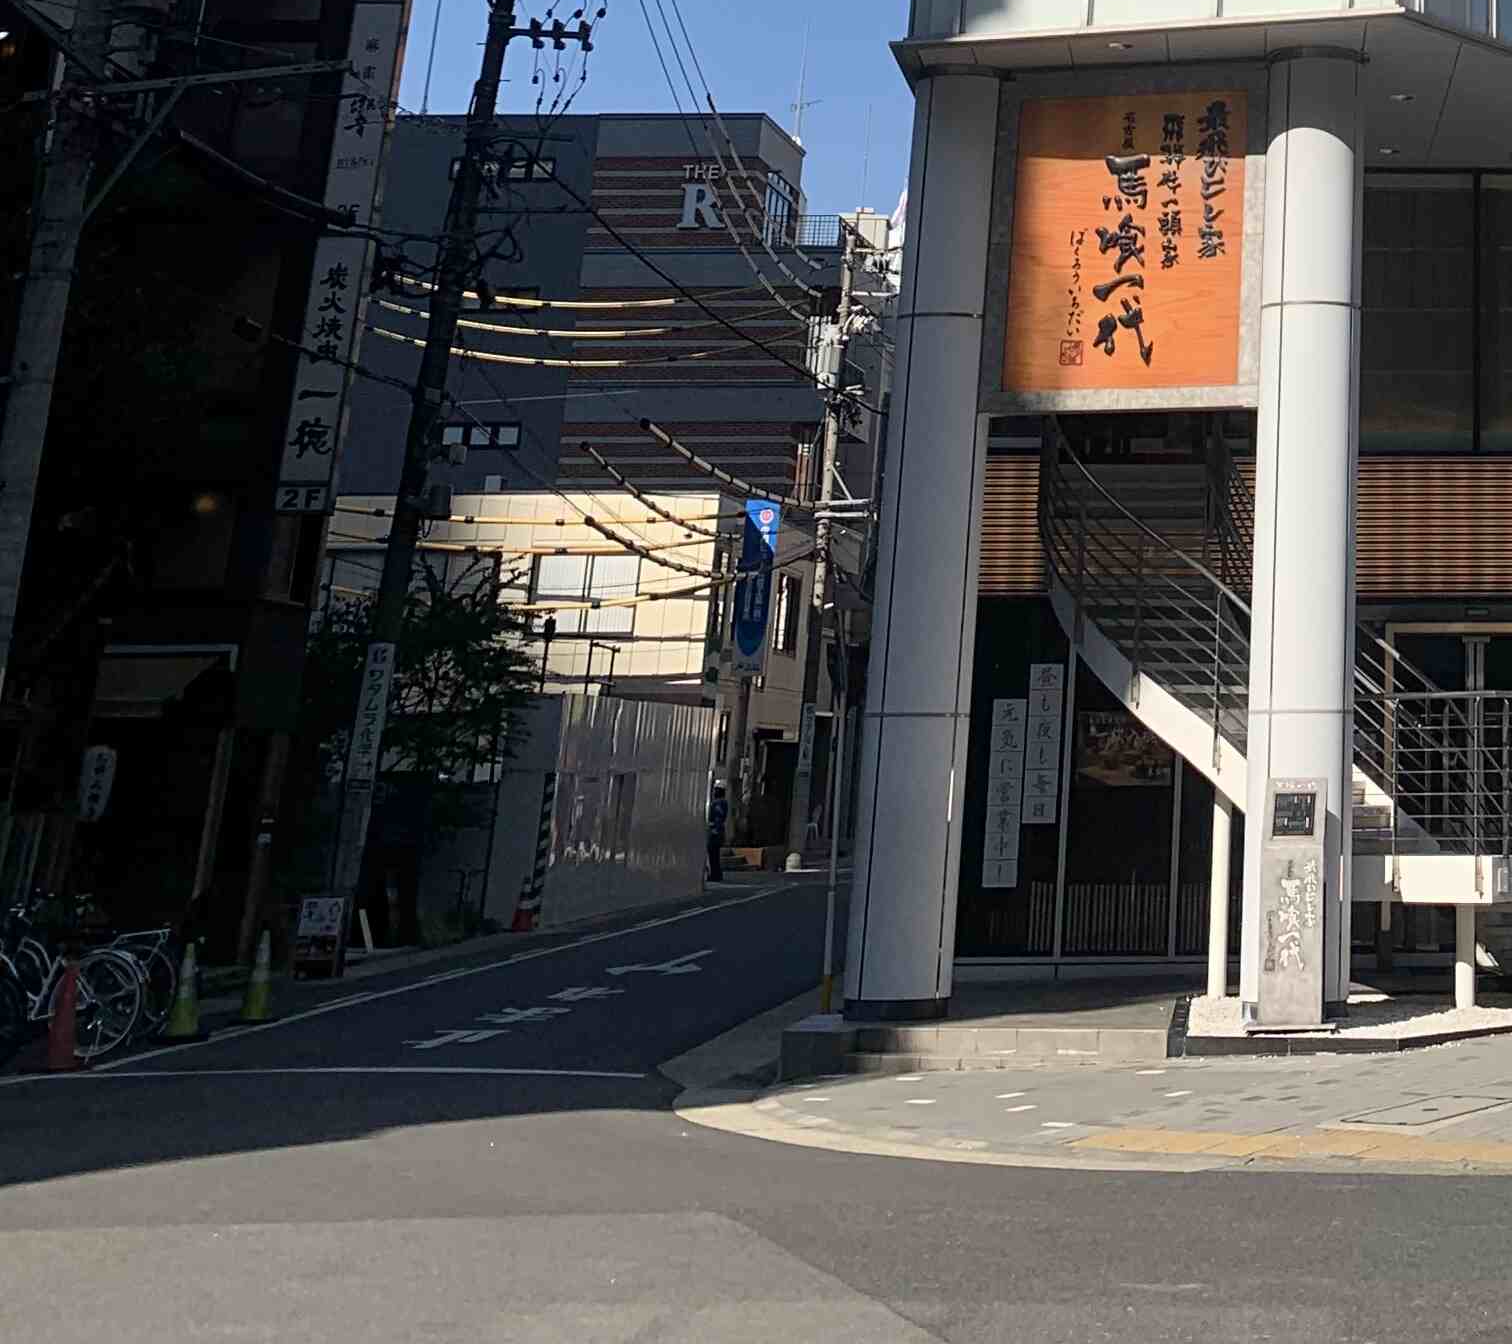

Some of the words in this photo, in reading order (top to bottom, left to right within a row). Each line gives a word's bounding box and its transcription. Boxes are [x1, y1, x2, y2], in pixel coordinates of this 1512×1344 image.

[682, 164, 721, 180] THE
[1092, 153, 1153, 368] 馬喰一代
[282, 488, 321, 510] 2F
